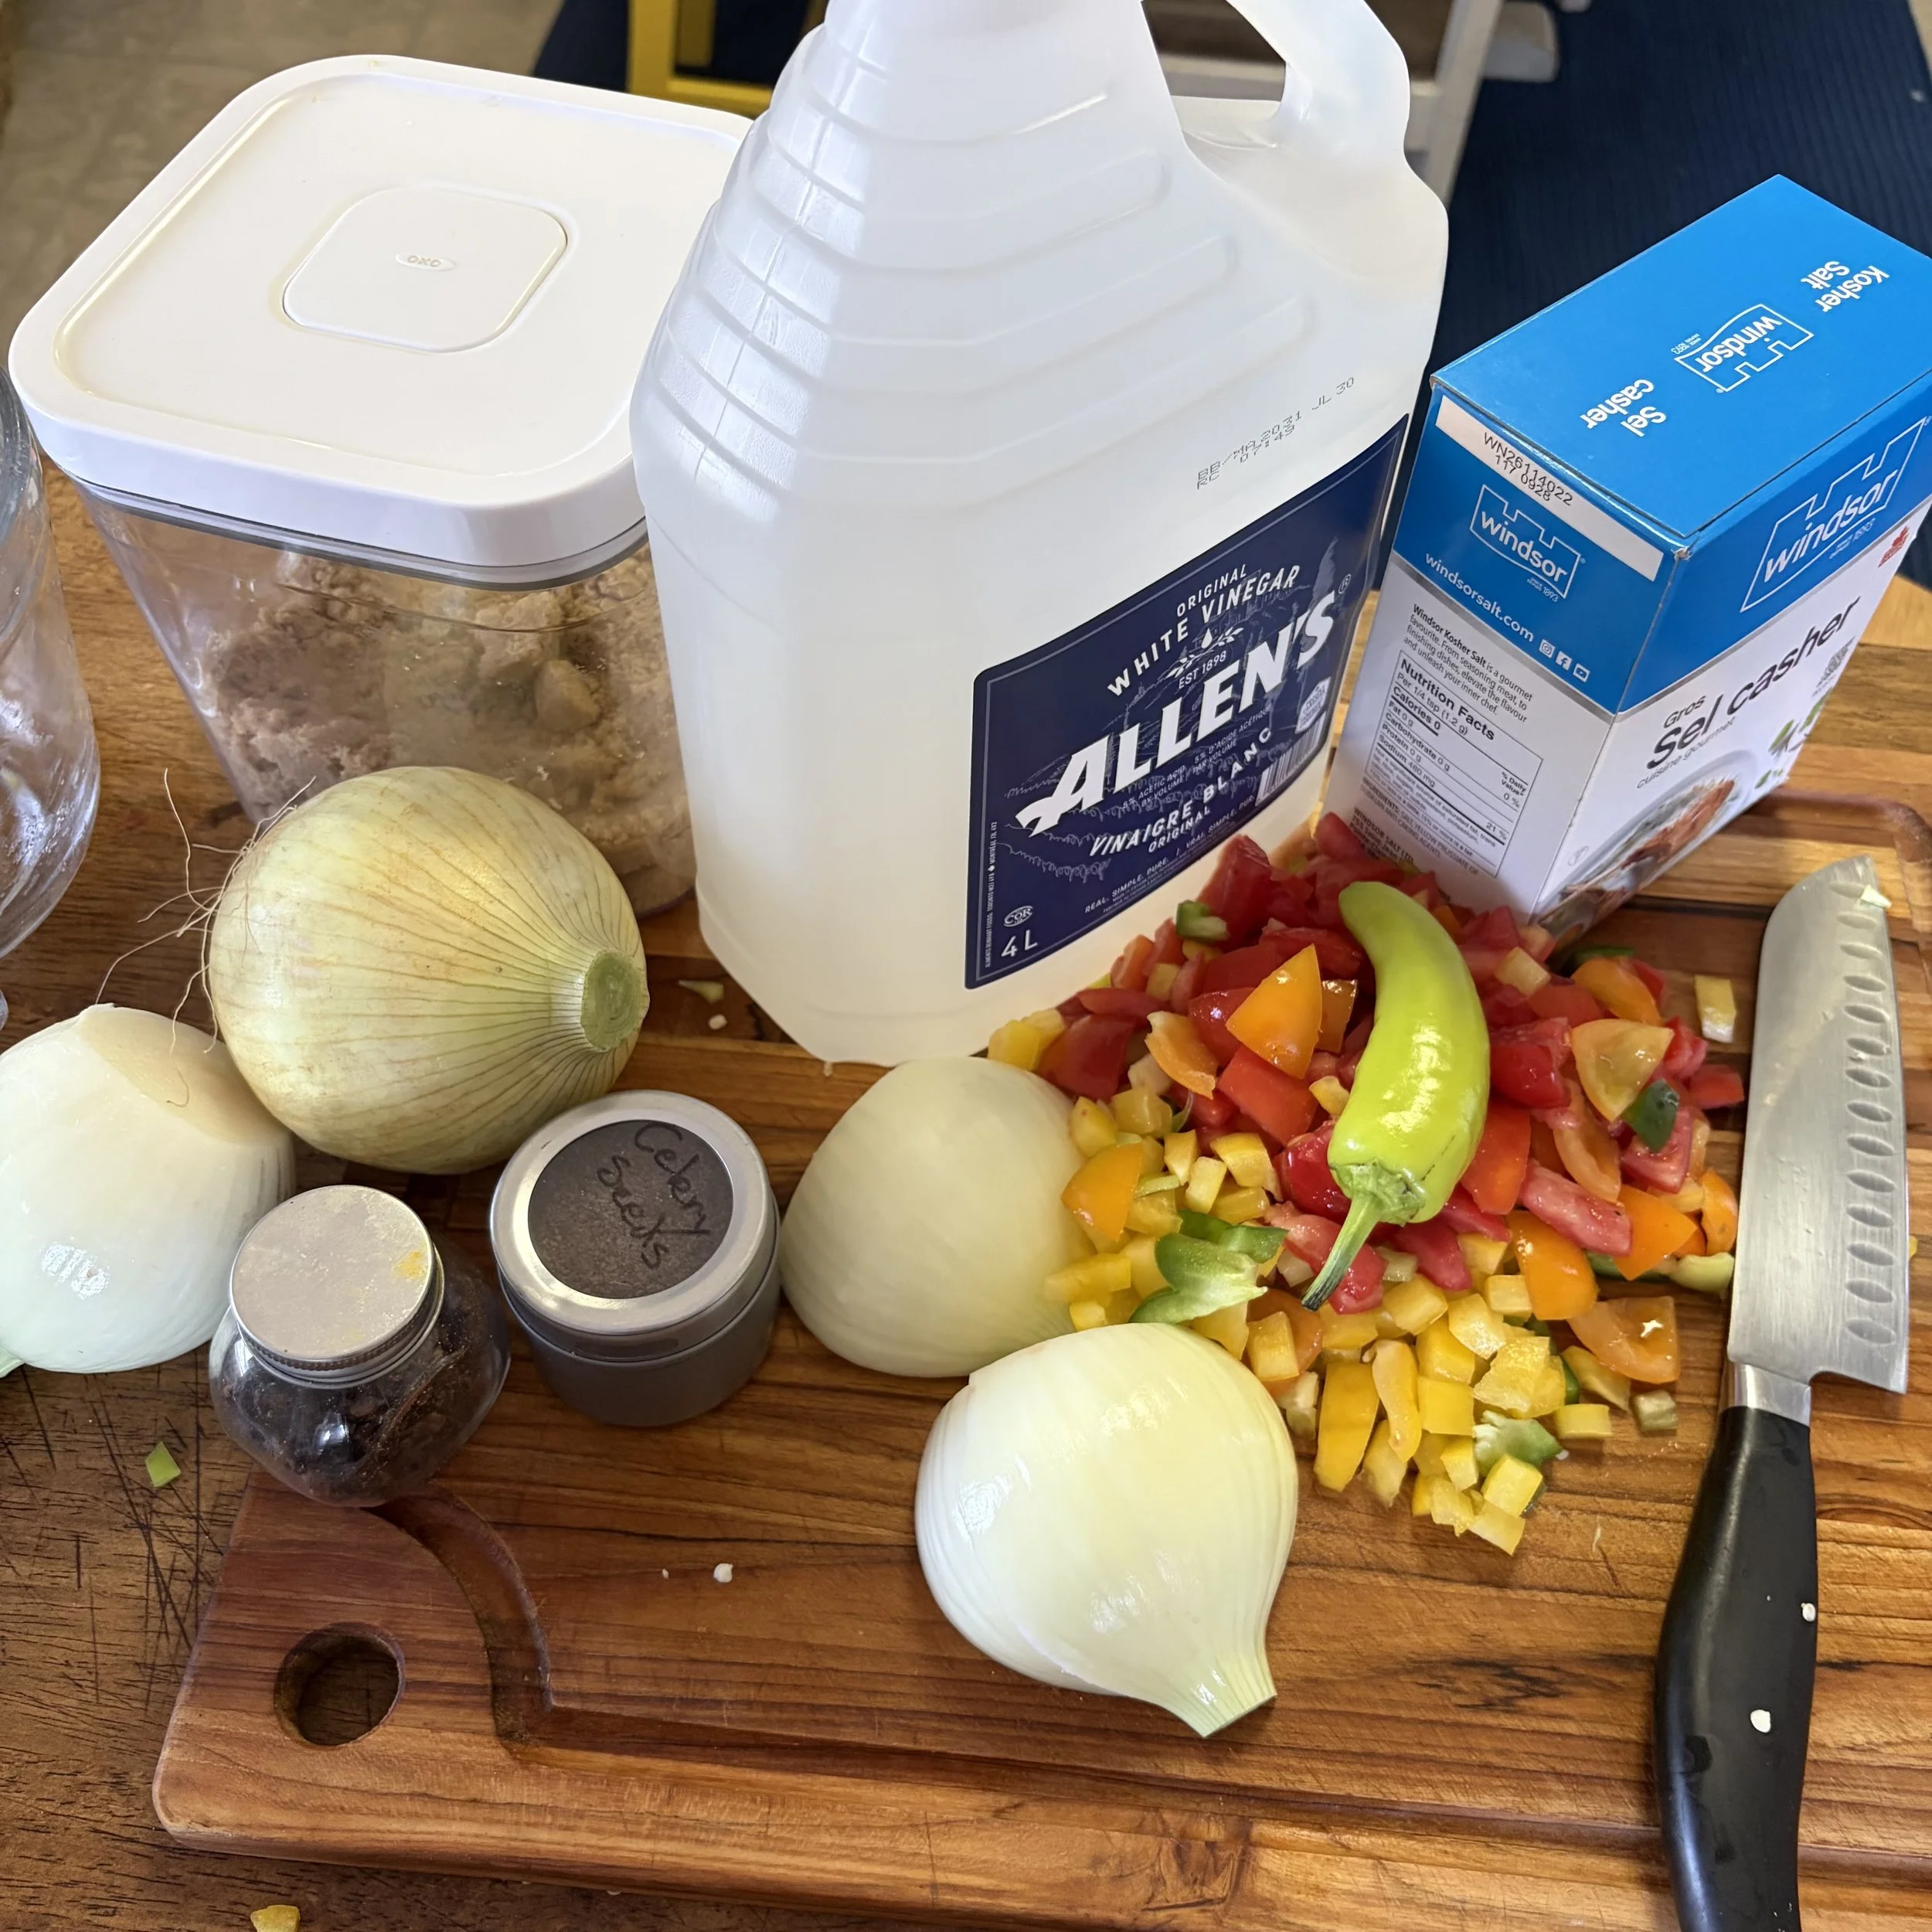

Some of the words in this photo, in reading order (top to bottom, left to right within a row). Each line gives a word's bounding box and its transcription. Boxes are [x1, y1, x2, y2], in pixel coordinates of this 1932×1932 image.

[408, 255, 441, 267] OXO
[1800, 260, 1851, 291] Salt
[1815, 264, 1890, 313] Kosher
[1694, 315, 1783, 372] windsor
[1336, 376, 1354, 395] 30
[1580, 378, 1655, 430] casher
[1621, 405, 1666, 437] Sel
[1483, 431, 1573, 506] WN26114022
[1520, 473, 1551, 502] 0928
[1481, 511, 1567, 582] windsor
[1764, 469, 1899, 583] windsor
[1177, 563, 1247, 617] ORIGINAL
[1425, 553, 1534, 643] windsorsalt.com
[1107, 617, 1188, 696] WHITE
[1202, 565, 1300, 623] VINEGAR
[1412, 604, 1444, 634] Windsor
[1444, 629, 1470, 655] Kosher
[1470, 649, 1486, 668] Salt
[1485, 662, 1493, 673] is
[1492, 668, 1498, 678] a
[1498, 672, 1532, 705] gourmet
[1179, 668, 1199, 690] EST
[1202, 651, 1226, 675] 1898
[1403, 635, 1417, 651] and
[1417, 647, 1444, 673] unleash
[1443, 668, 1461, 689] your
[1461, 681, 1480, 702] inner
[1480, 695, 1498, 716] chef.
[1405, 624, 1437, 656] finishing
[1435, 648, 1461, 675] dishes,
[1461, 668, 1488, 695] elevate
[1486, 688, 1501, 704] the
[1500, 698, 1527, 724] flavour
[1409, 613, 1442, 646] favourite.
[1440, 640, 1460, 661] From
[1458, 655, 1496, 690] seasoning
[1496, 682, 1519, 706] meat,
[1518, 700, 1527, 711] to
[1646, 694, 1724, 770] Sel
[1726, 596, 1862, 716] casher
[1015, 590, 1335, 838] ALLEN'S
[1388, 700, 1401, 716] Fat
[1401, 711, 1407, 721] 0
[1407, 718, 1413, 727] g
[1392, 685, 1433, 724] Calories
[1433, 719, 1440, 731] 0
[1396, 671, 1412, 689] Per
[1413, 686, 1425, 700] 1/4
[1426, 696, 1440, 714] tsp
[1440, 708, 1458, 728] (1.2
[1458, 722, 1468, 736] g)
[1400, 658, 1456, 710] Nutrition
[1457, 705, 1495, 741] Facts
[1663, 695, 1706, 729] Gros
[1378, 733, 1407, 763] Sodium
[1422, 773, 1435, 788] mg
[1381, 723, 1409, 750] Protein
[1409, 747, 1415, 757] 0
[1415, 753, 1421, 763] g
[1384, 712, 1437, 760] Carbohydrate
[1437, 756, 1444, 765] 0
[1444, 763, 1450, 772] g
[1089, 800, 1193, 856] VINAIGRE
[1203, 727, 1271, 804] BLANC
[1502, 791, 1510, 801] 0
[1509, 776, 1526, 794] Daily
[1148, 806, 1210, 852] ORIGINAL
[1485, 821, 1495, 833] 21
[1005, 908, 1031, 924] COR
[1001, 936, 1018, 957] 4
[1025, 930, 1038, 951] L
